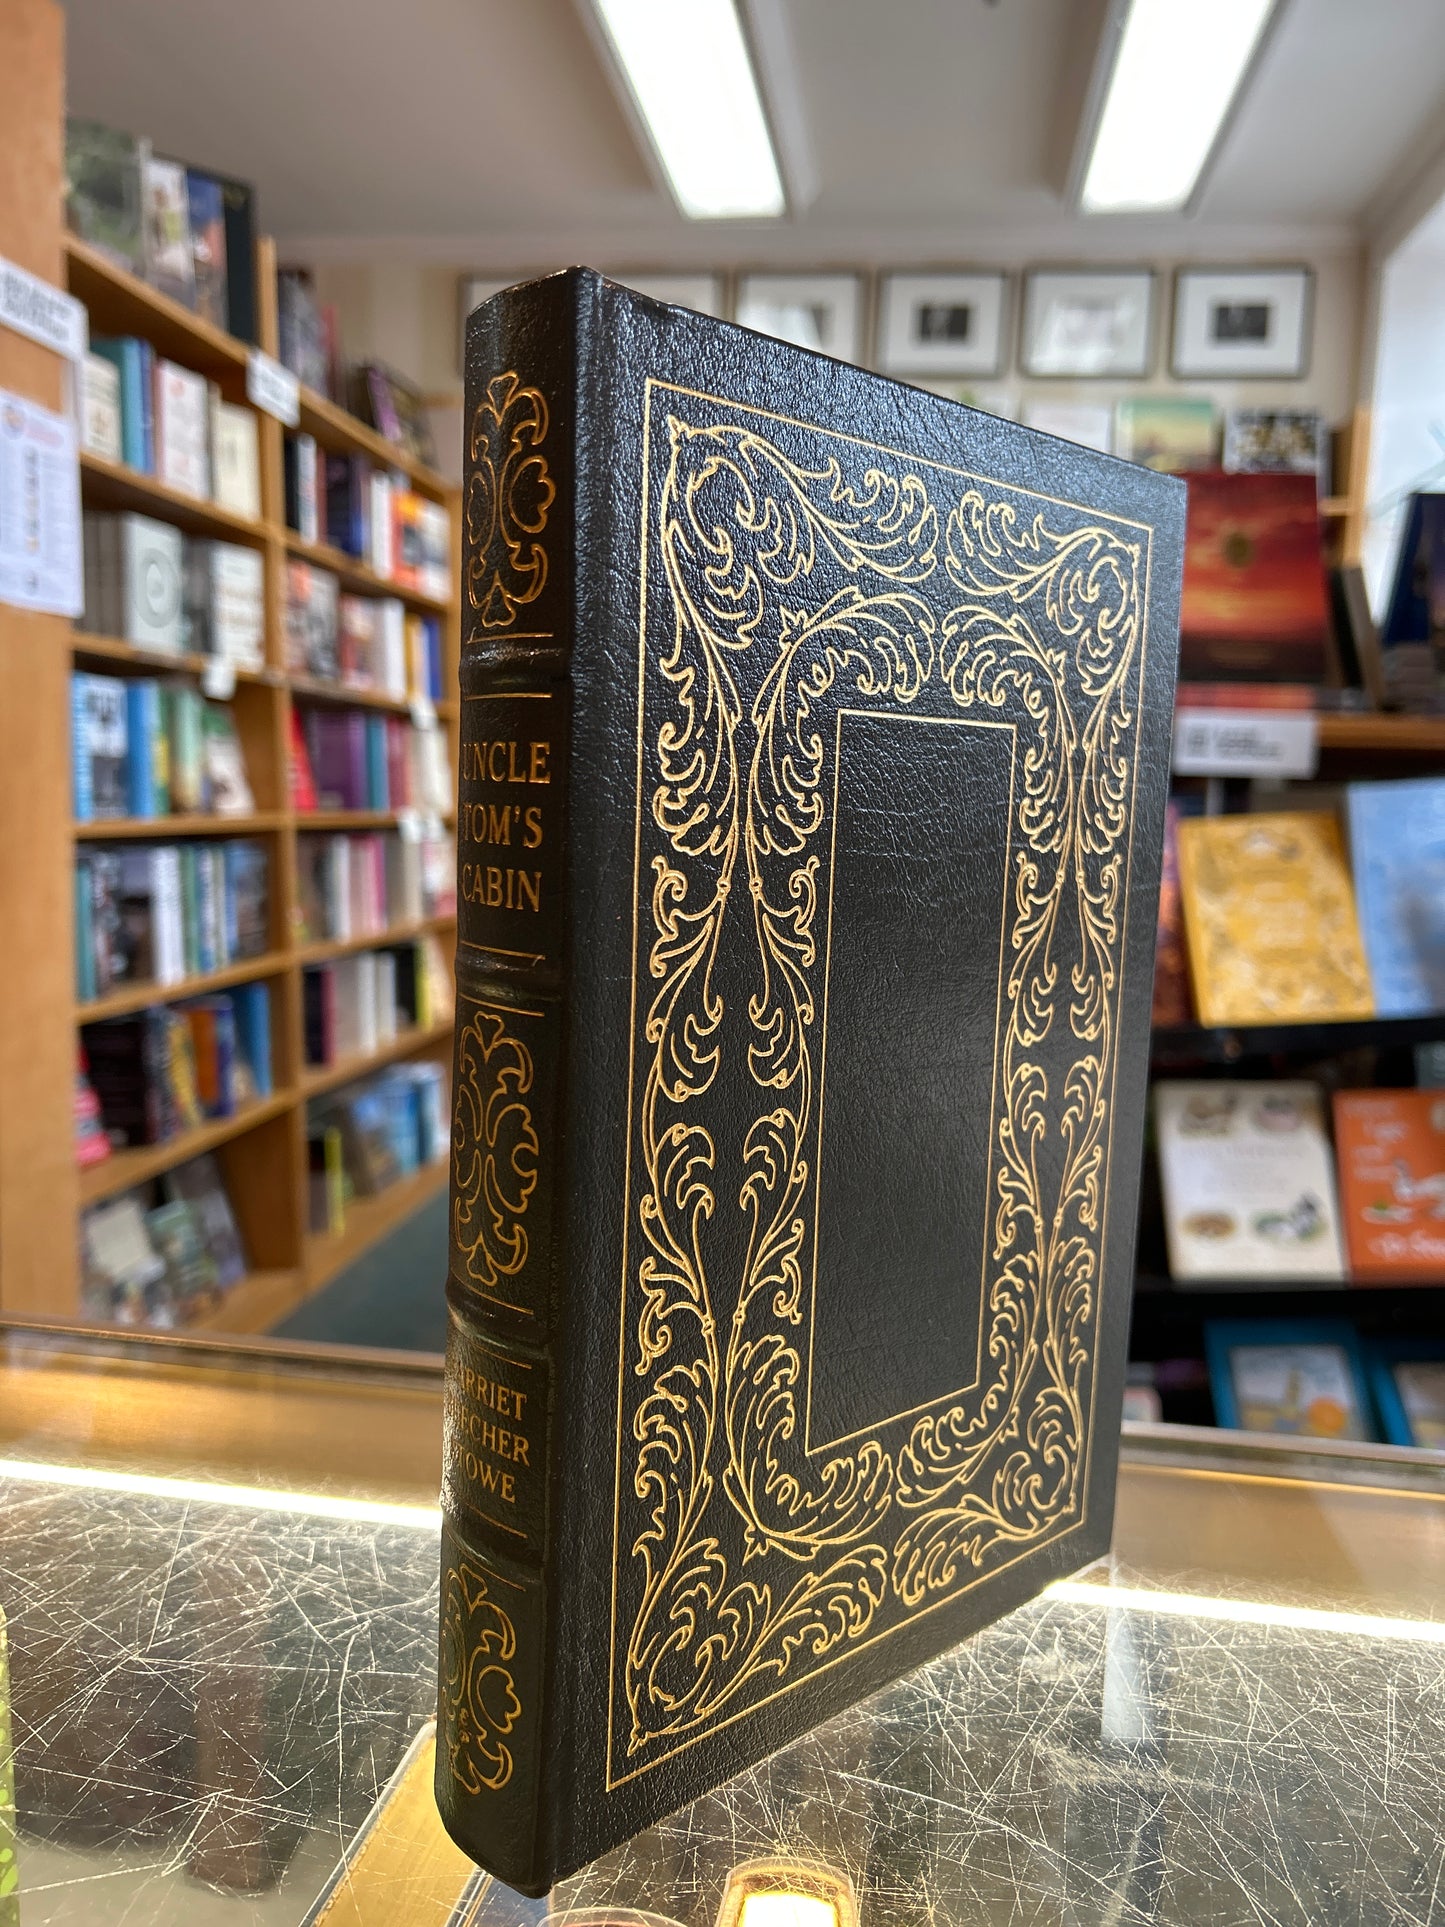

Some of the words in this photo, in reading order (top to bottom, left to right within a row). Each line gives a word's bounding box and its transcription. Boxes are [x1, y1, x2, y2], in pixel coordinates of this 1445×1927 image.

[463, 741, 551, 784] UNCLE
[463, 802, 544, 849] TOM'S
[462, 863, 542, 912] CABIN
[452, 1440, 516, 1503] TOWE
